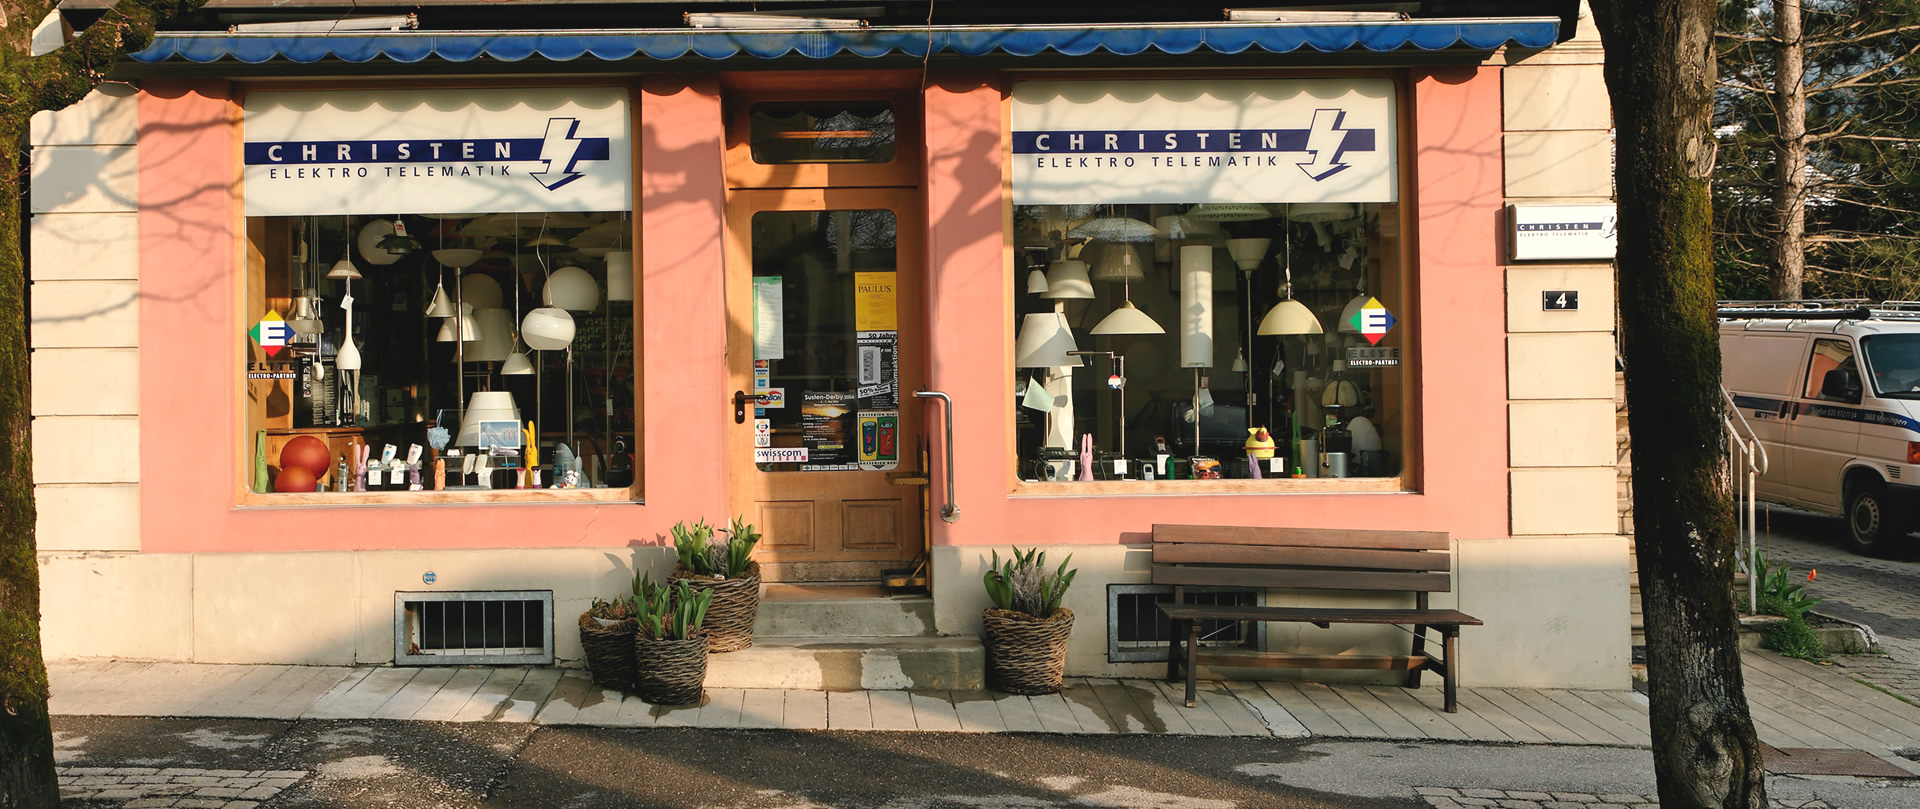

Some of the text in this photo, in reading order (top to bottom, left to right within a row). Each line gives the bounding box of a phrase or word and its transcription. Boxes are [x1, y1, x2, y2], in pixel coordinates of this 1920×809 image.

[1035, 132, 1278, 151] CHRISTEN
[267, 141, 512, 162] CHRISTEN
[1037, 155, 1278, 169] ELEKTRO TELEMATIK
[269, 165, 512, 179] ELEKTRO TELEMATIK
[1519, 223, 1590, 231] CHRISTEN
[858, 285, 892, 293] PAULUS
[1556, 292, 1567, 308] 4
[1349, 348, 1399, 358] ELITE
[247, 362, 296, 371] ELITE
[1876, 414, 1908, 426] Meiringen
[756, 448, 802, 457] swisscom
